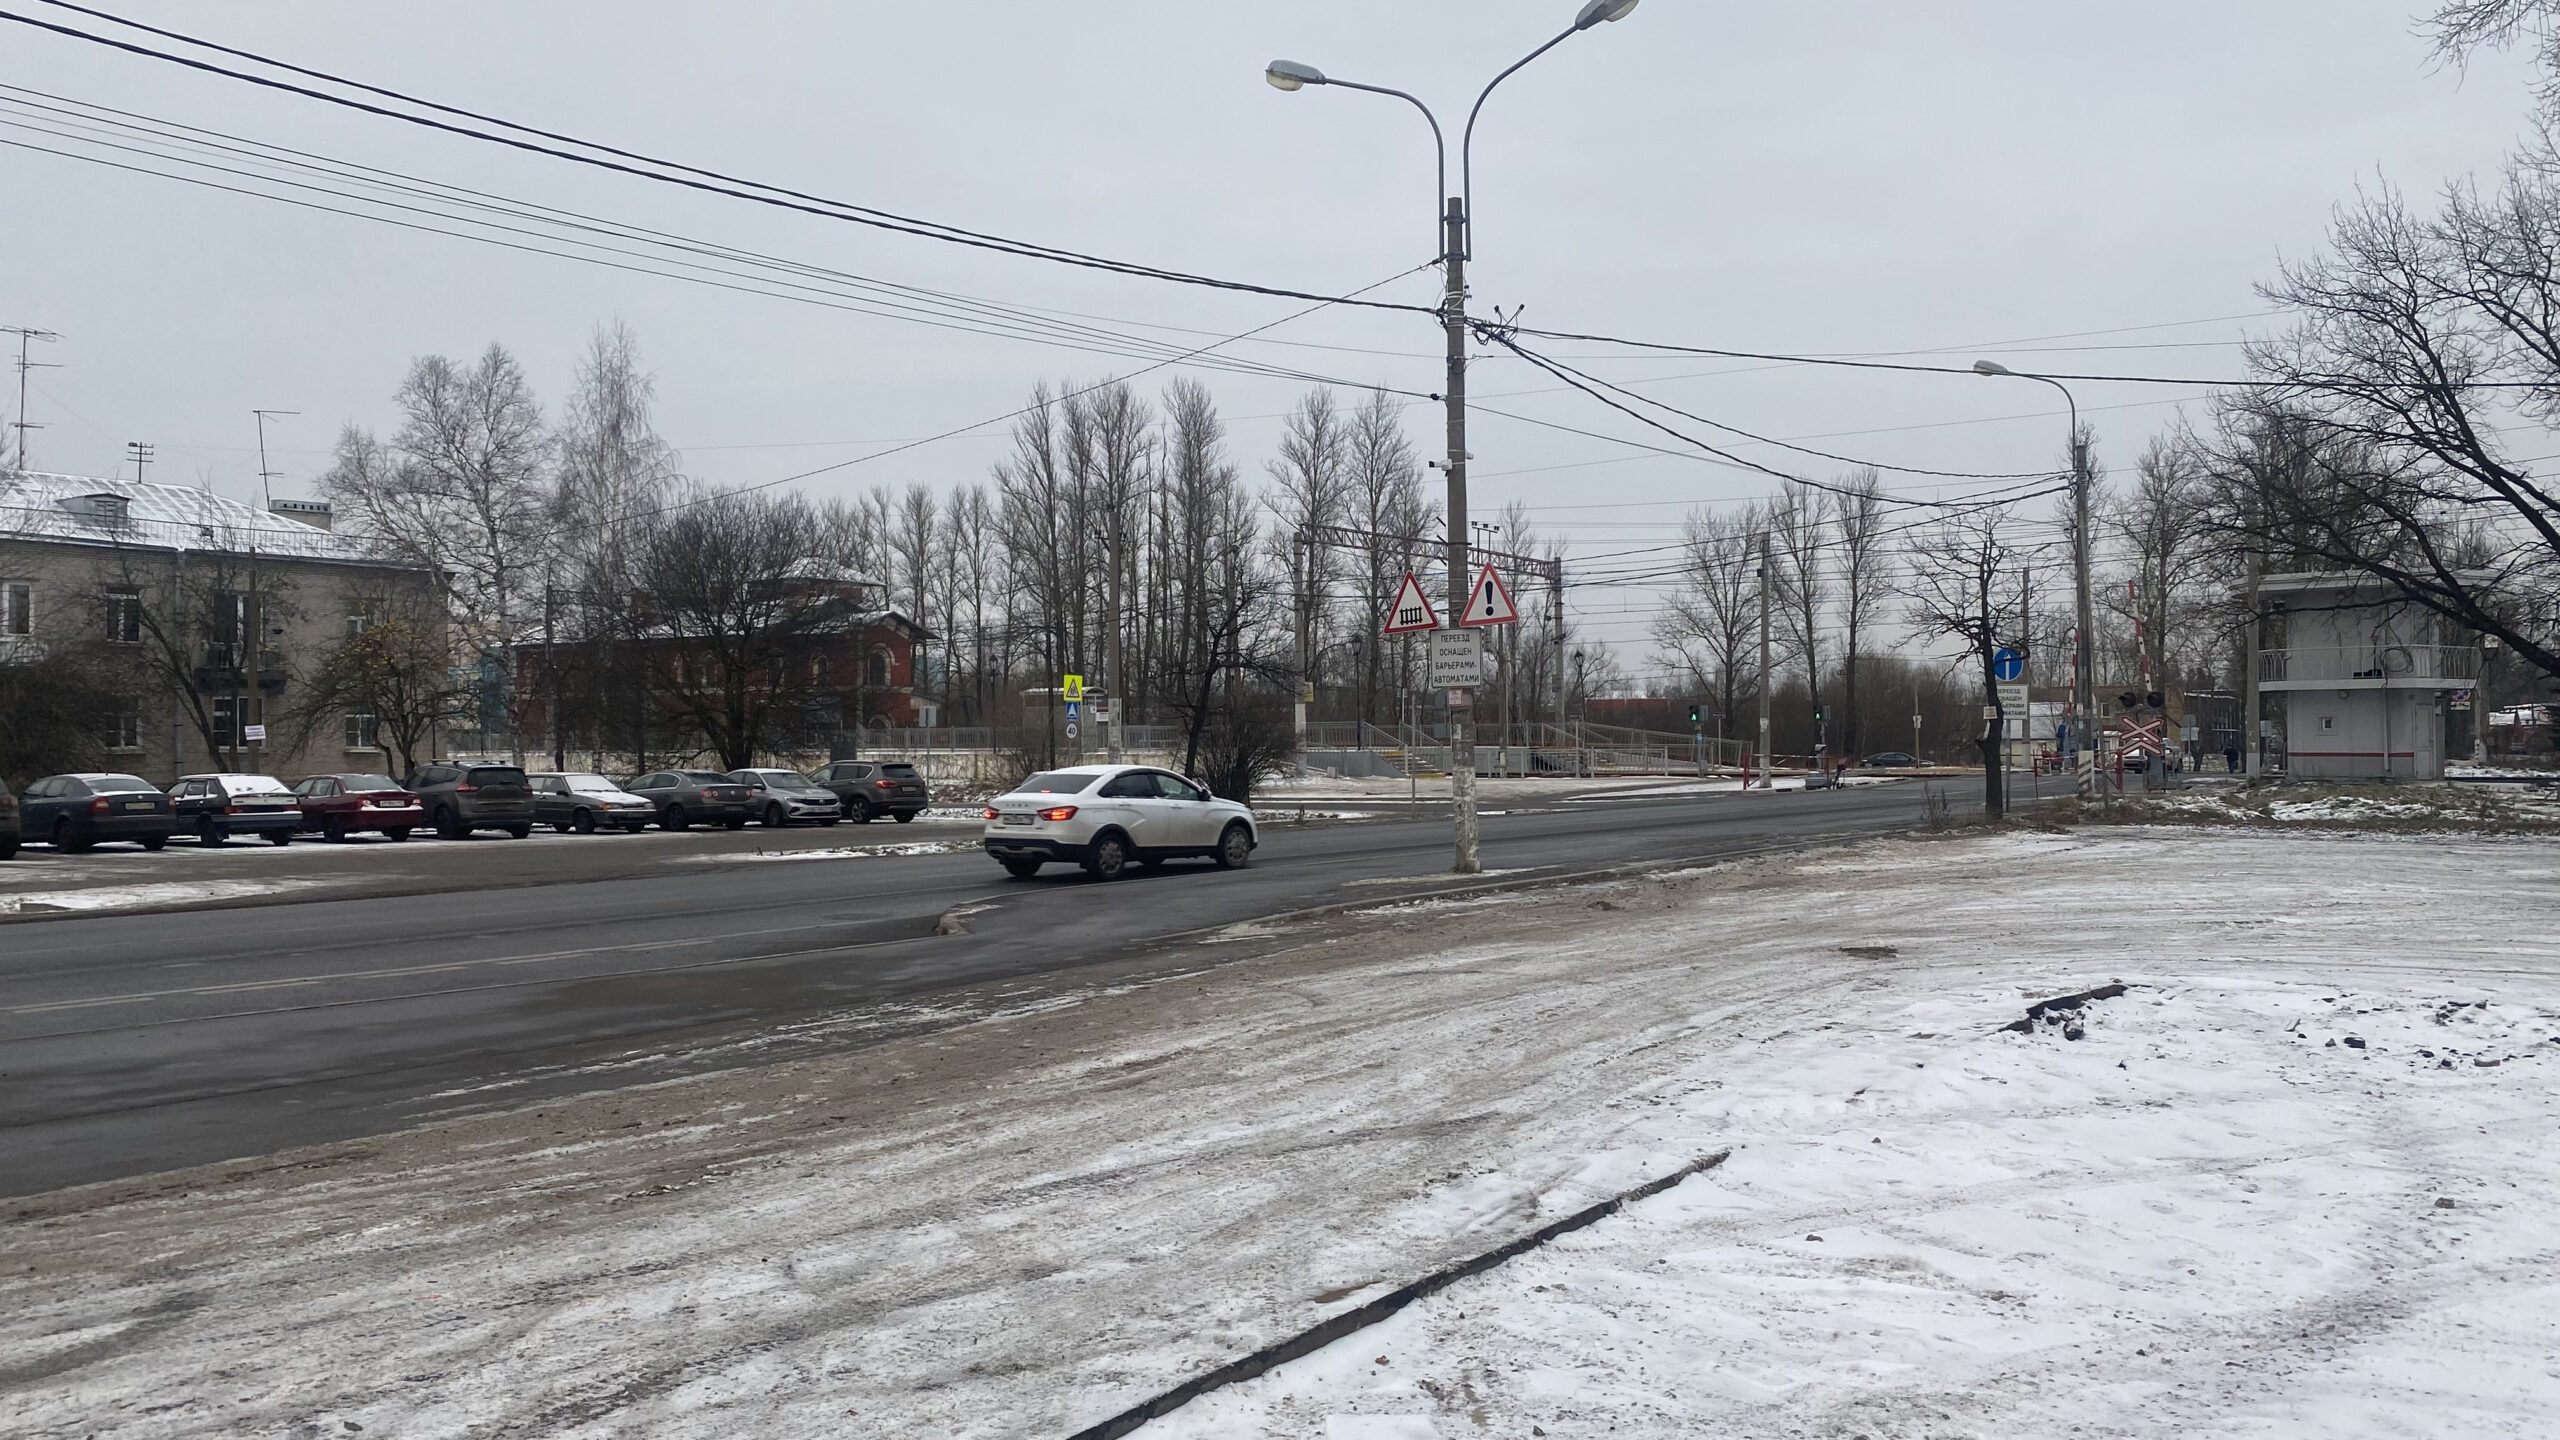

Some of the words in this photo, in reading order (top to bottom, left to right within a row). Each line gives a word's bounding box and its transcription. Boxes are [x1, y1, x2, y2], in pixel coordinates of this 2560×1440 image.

[1441, 634, 1470, 642] ПЕРЕЕЗД
[1440, 648, 1472, 656] ОСНАЩЕН
[1434, 674, 1480, 683] АВТОМАТАМИ
